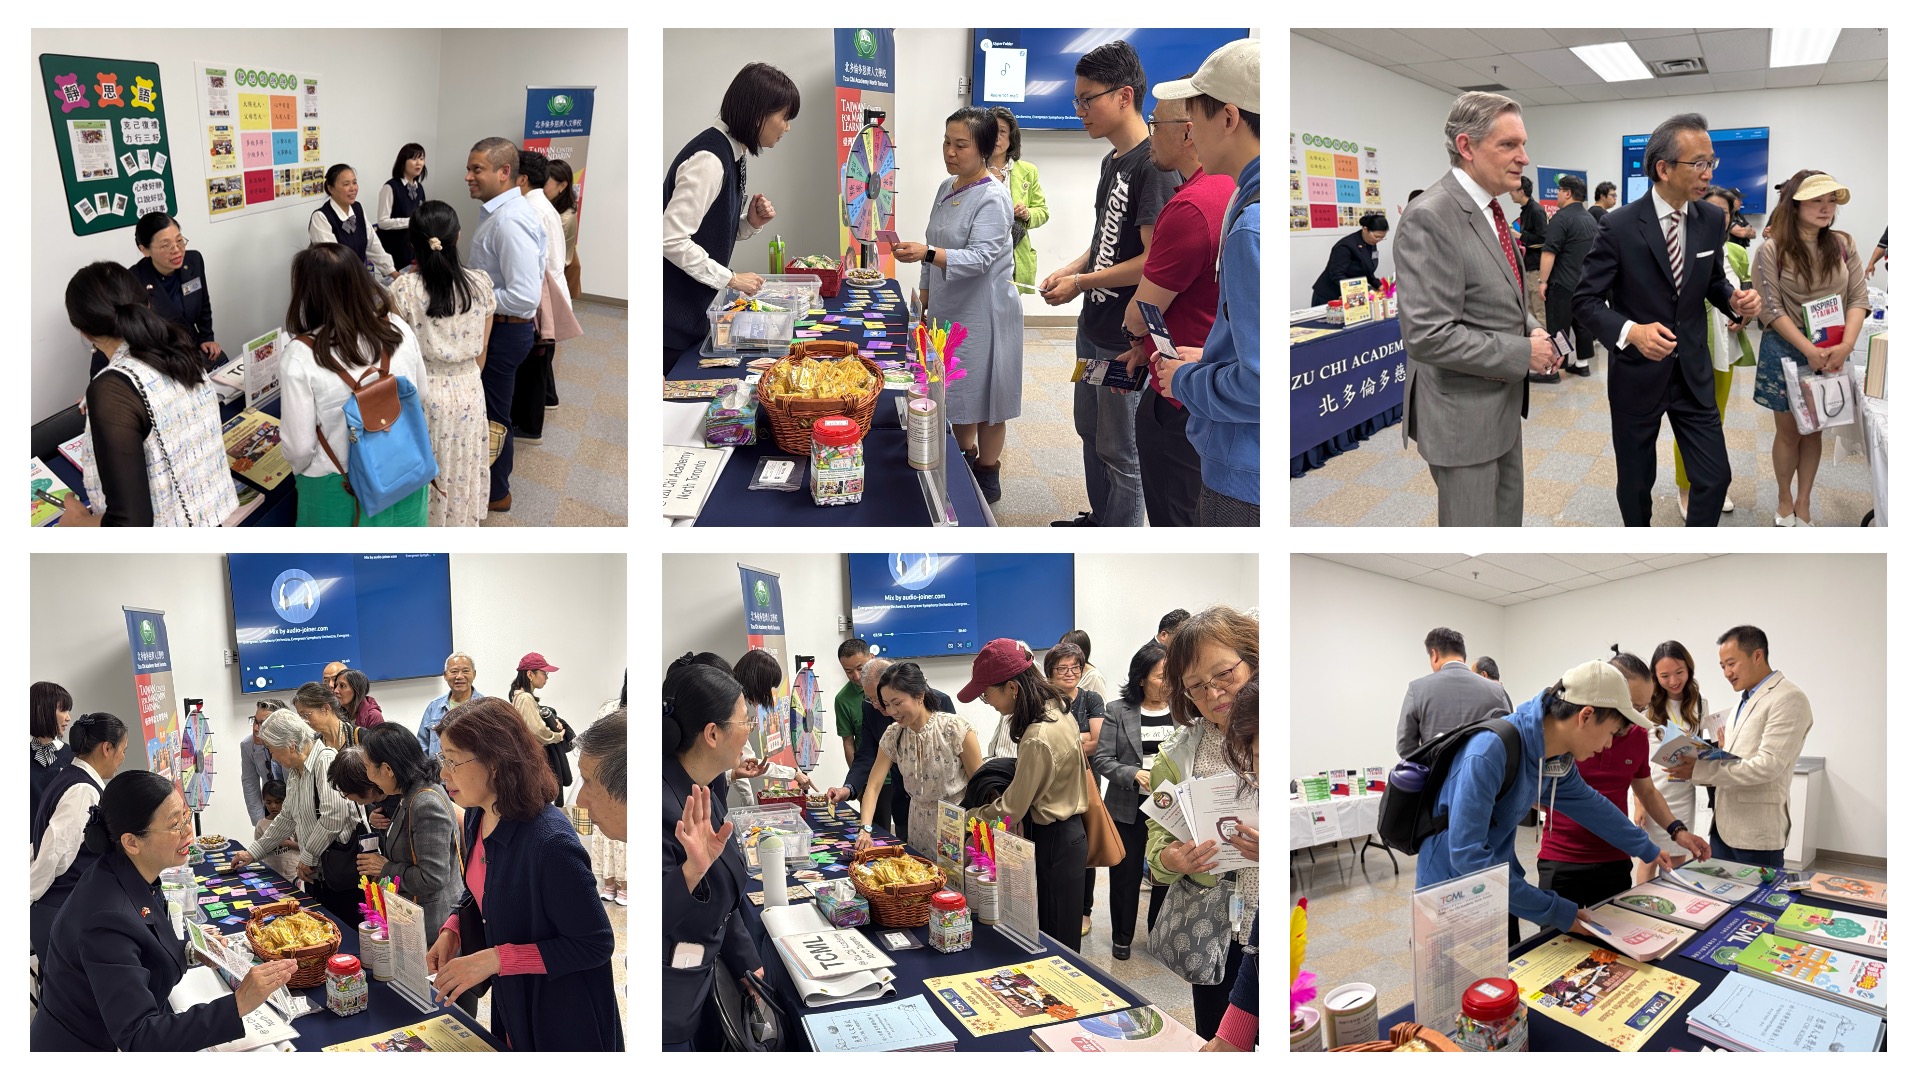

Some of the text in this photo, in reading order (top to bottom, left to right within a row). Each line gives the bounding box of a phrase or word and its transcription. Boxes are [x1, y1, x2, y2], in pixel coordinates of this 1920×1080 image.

[64, 84, 150, 103] 靜 思 語
[841, 99, 866, 112] TAIWAN
[123, 120, 158, 130] 克己復禮
[125, 133, 160, 143] 力行三好
[137, 192, 165, 204] 口說好話
[1810, 298, 1838, 313] INSPIRED
[1816, 306, 1839, 318] TAIWAN
[227, 363, 244, 376] TC
[1291, 339, 1404, 390] ZU CHI ACADEM
[669, 451, 694, 478] Academy
[663, 479, 677, 487] Chi
[676, 461, 706, 499] North Toronto
[286, 626, 328, 634] audio-joiner.com
[1441, 891, 1465, 904] TCML
[1727, 920, 1768, 943] TCML
[802, 935, 845, 970] TCML
[1646, 999, 1667, 1014] TCML
